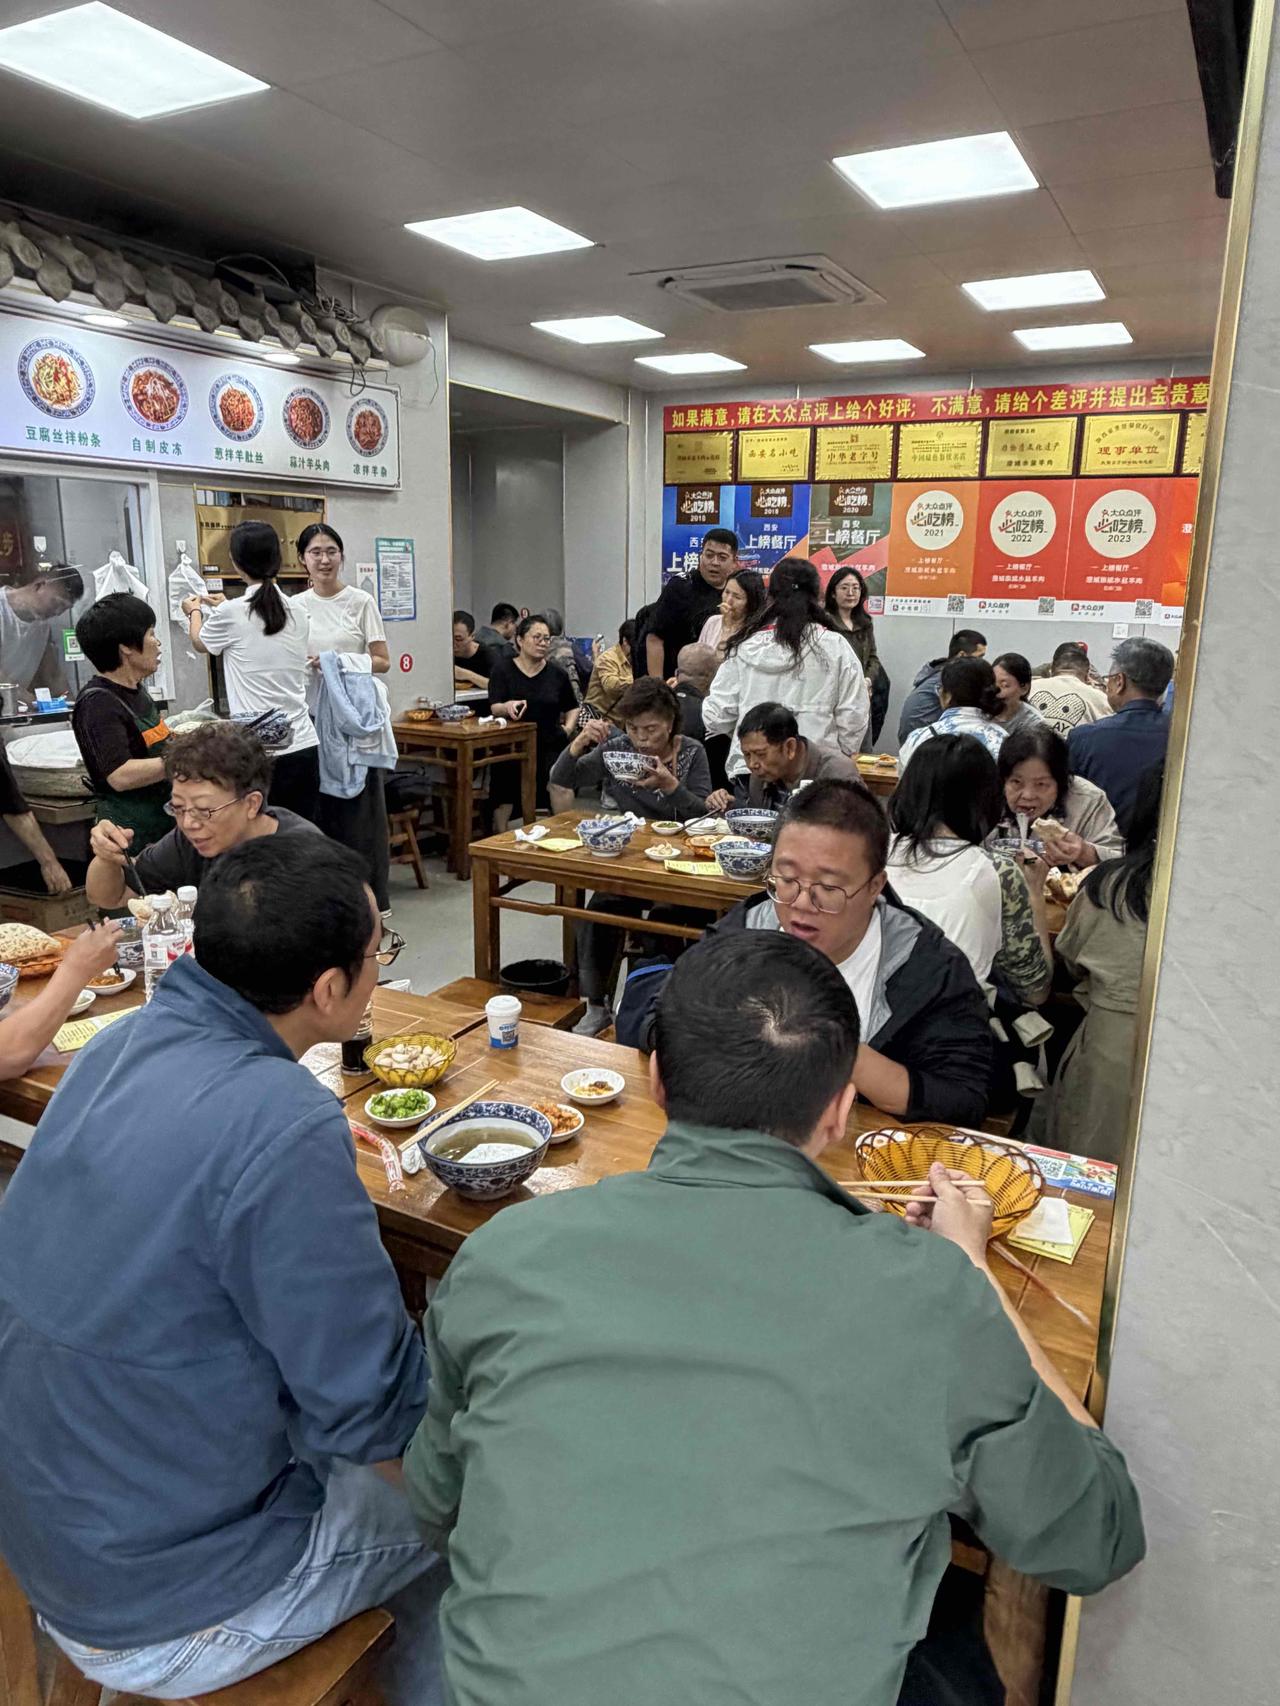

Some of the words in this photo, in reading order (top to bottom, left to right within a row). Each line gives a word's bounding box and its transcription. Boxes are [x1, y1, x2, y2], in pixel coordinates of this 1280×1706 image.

[26, 426, 101, 447] 豆腐丝拌粉条
[132, 437, 183, 456] 自制皮冻
[1096, 446, 1159, 455] 理事单位
[214, 447, 264, 465] 葱拌羊肚丝
[748, 448, 799, 459] 西安名小吃
[827, 450, 878, 463] 中华老字号
[353, 464, 388, 478] 凉拌羊杂
[691, 491, 714, 500] 大众点评
[844, 487, 867, 495] 大众点评
[756, 496, 788, 508] 必吃榜
[834, 495, 868, 506] 必吃榜
[925, 502, 953, 510] 大众点评
[681, 500, 715, 514] 必吃榜
[1110, 509, 1142, 517] 大众点评
[910, 512, 955, 527] 必吃榜
[1013, 509, 1043, 518] 大众点评
[763, 523, 779, 532] 西安
[842, 520, 861, 528] 西安
[997, 519, 1045, 534] 必吃榜
[1094, 518, 1143, 534] 必吃榜
[820, 529, 880, 545] 上榜餐厅
[924, 528, 944, 537] 2021
[1010, 534, 1032, 543] 2022
[1107, 534, 1131, 543] 2023
[690, 537, 704, 548] 西
[745, 534, 796, 549] 上榜餐厅
[667, 552, 699, 573] 上榜
[403, 656, 410, 670] 8
[1049, 721, 1071, 733] AY
